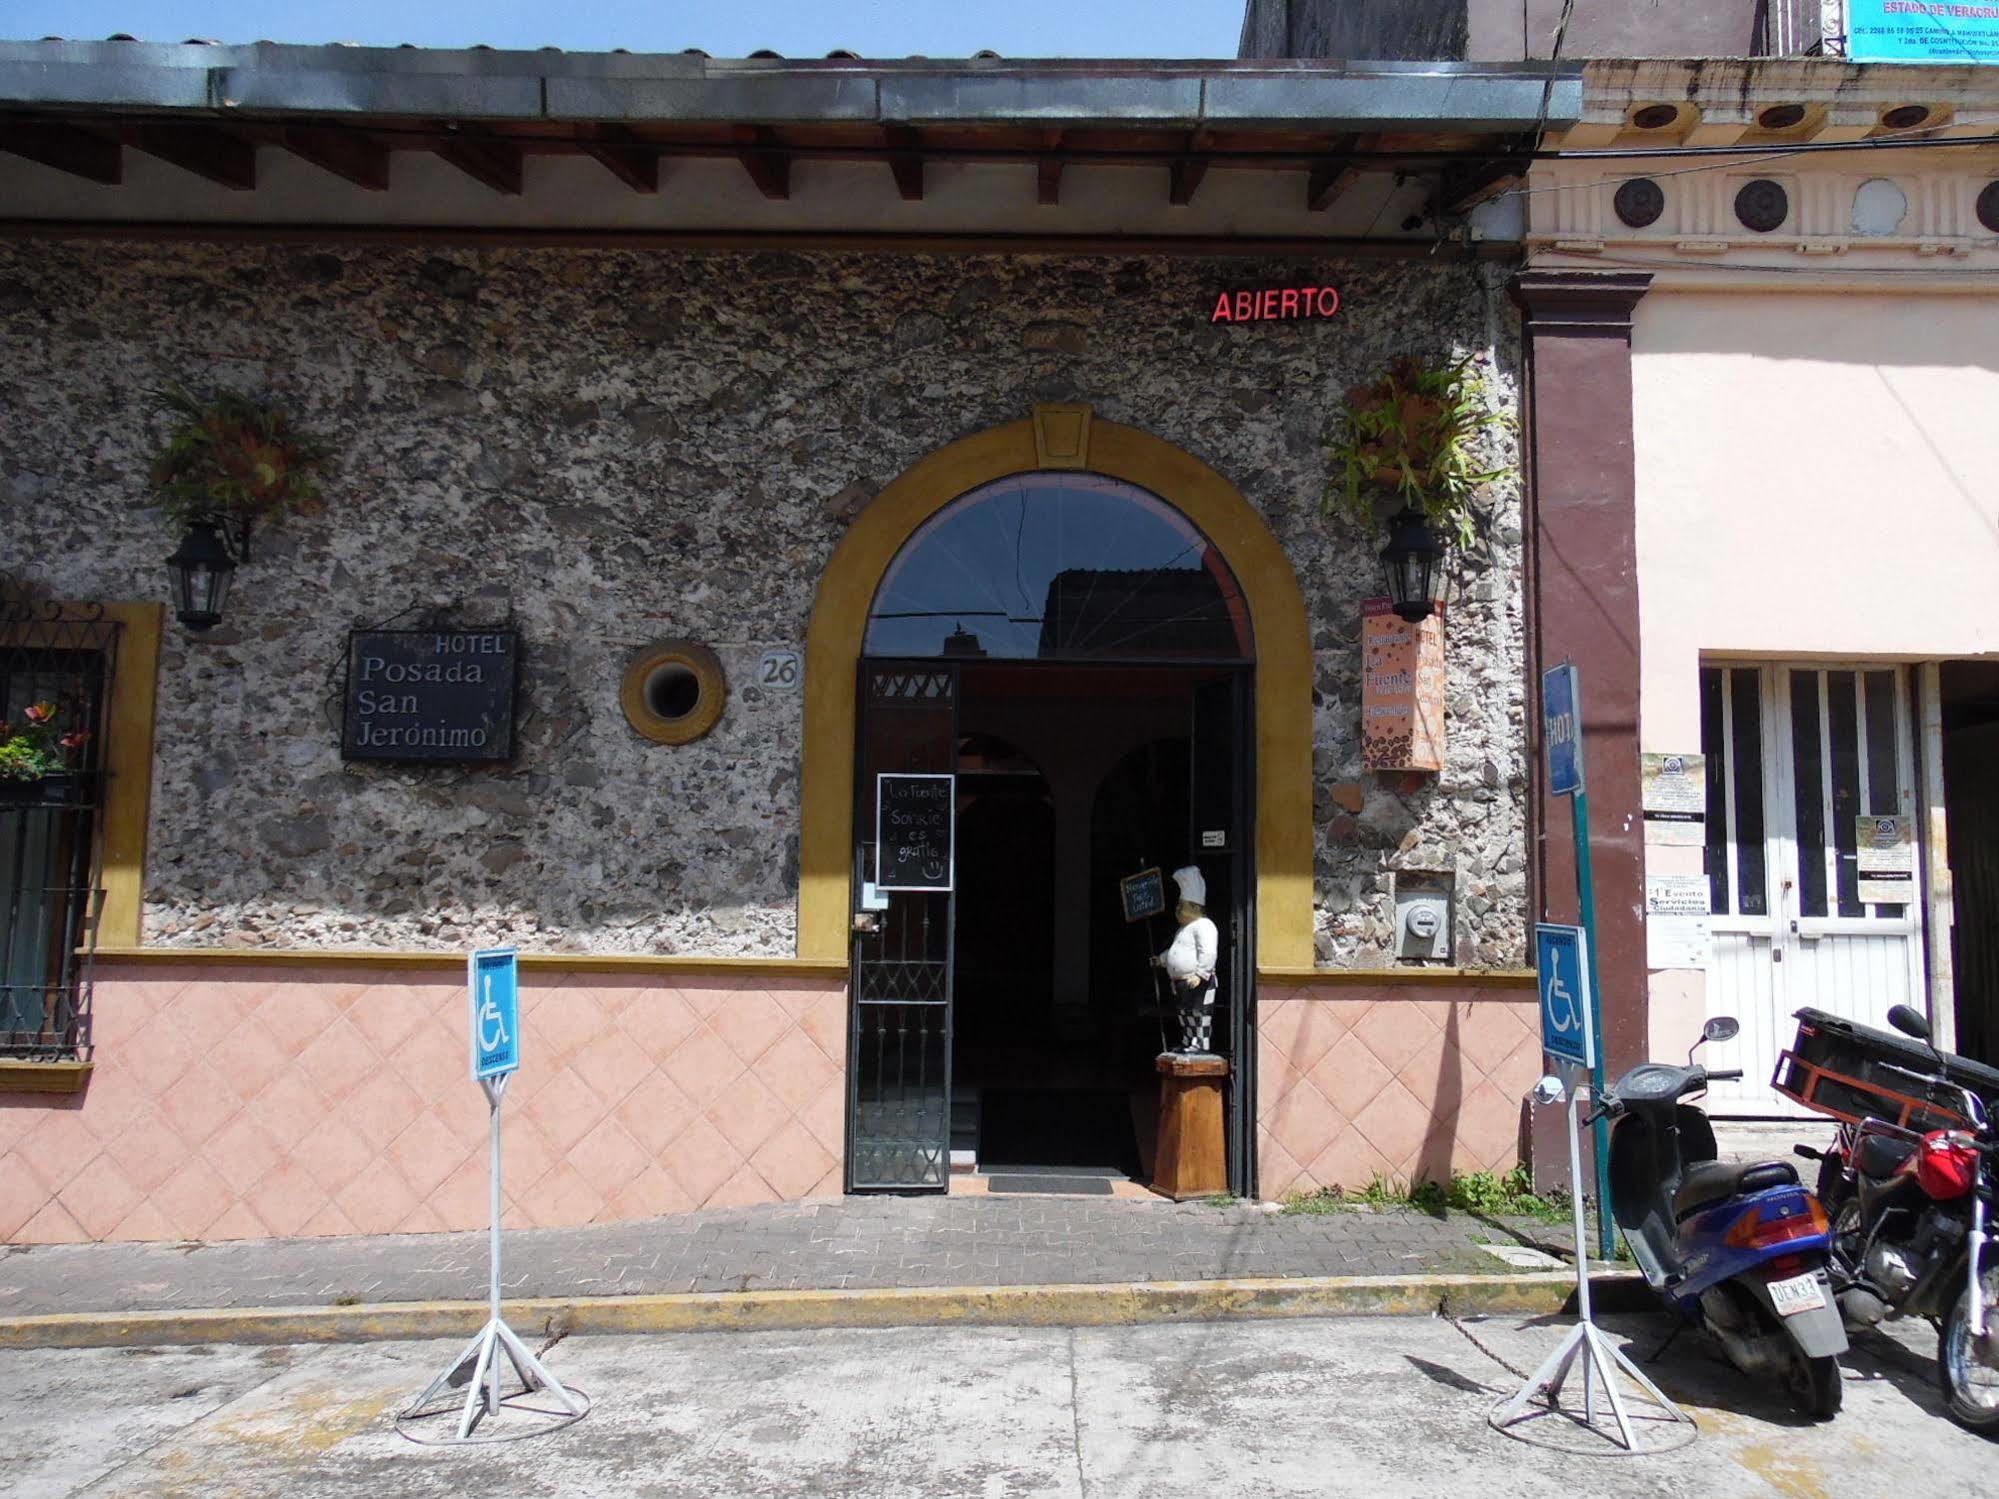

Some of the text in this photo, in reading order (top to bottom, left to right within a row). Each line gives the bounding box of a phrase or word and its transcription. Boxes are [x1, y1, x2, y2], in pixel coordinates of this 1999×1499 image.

[1884, 1, 1999, 19] ESTADO DE VERACRU
[1211, 287, 1339, 323] ABIERTO
[436, 634, 506, 654] HOTEL
[360, 656, 485, 683] Posada
[763, 657, 796, 684] 26
[358, 689, 419, 715] San
